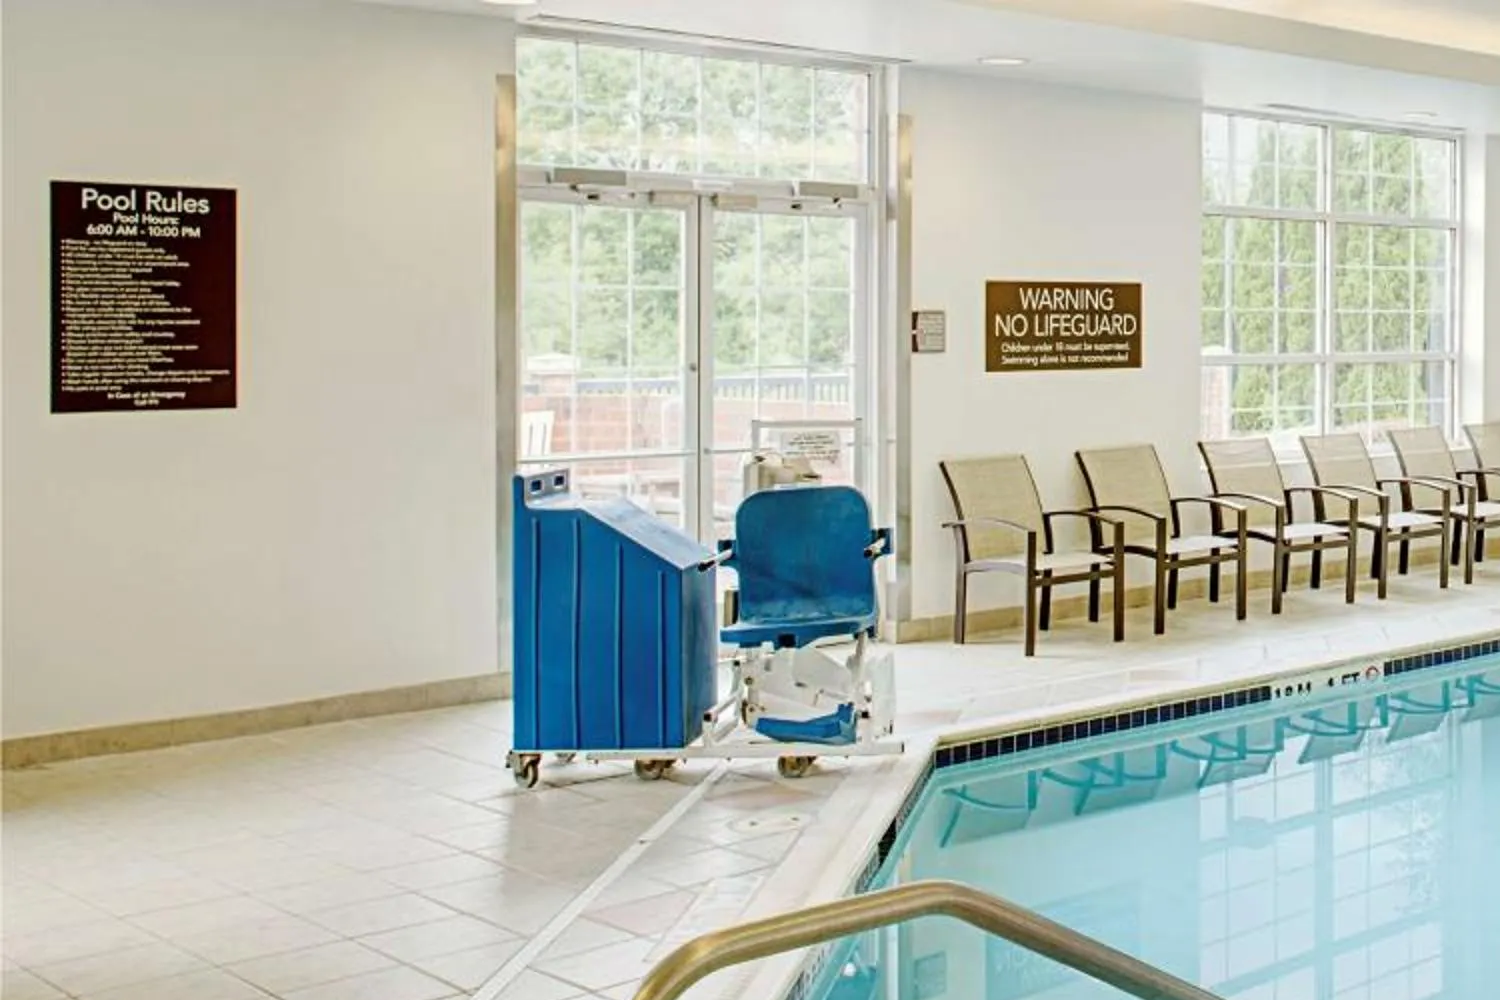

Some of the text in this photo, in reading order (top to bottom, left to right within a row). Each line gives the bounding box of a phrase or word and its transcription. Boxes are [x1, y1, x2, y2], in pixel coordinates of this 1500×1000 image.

[81, 187, 210, 214] Pool Rules
[113, 211, 139, 224] Pool
[86, 223, 113, 236] 6:00
[115, 224, 138, 236] AM
[148, 226, 179, 237] 10:00
[181, 226, 201, 237] PM
[1019, 287, 1114, 311] WARNING
[994, 313, 1137, 337] NO LIFEGUARD
